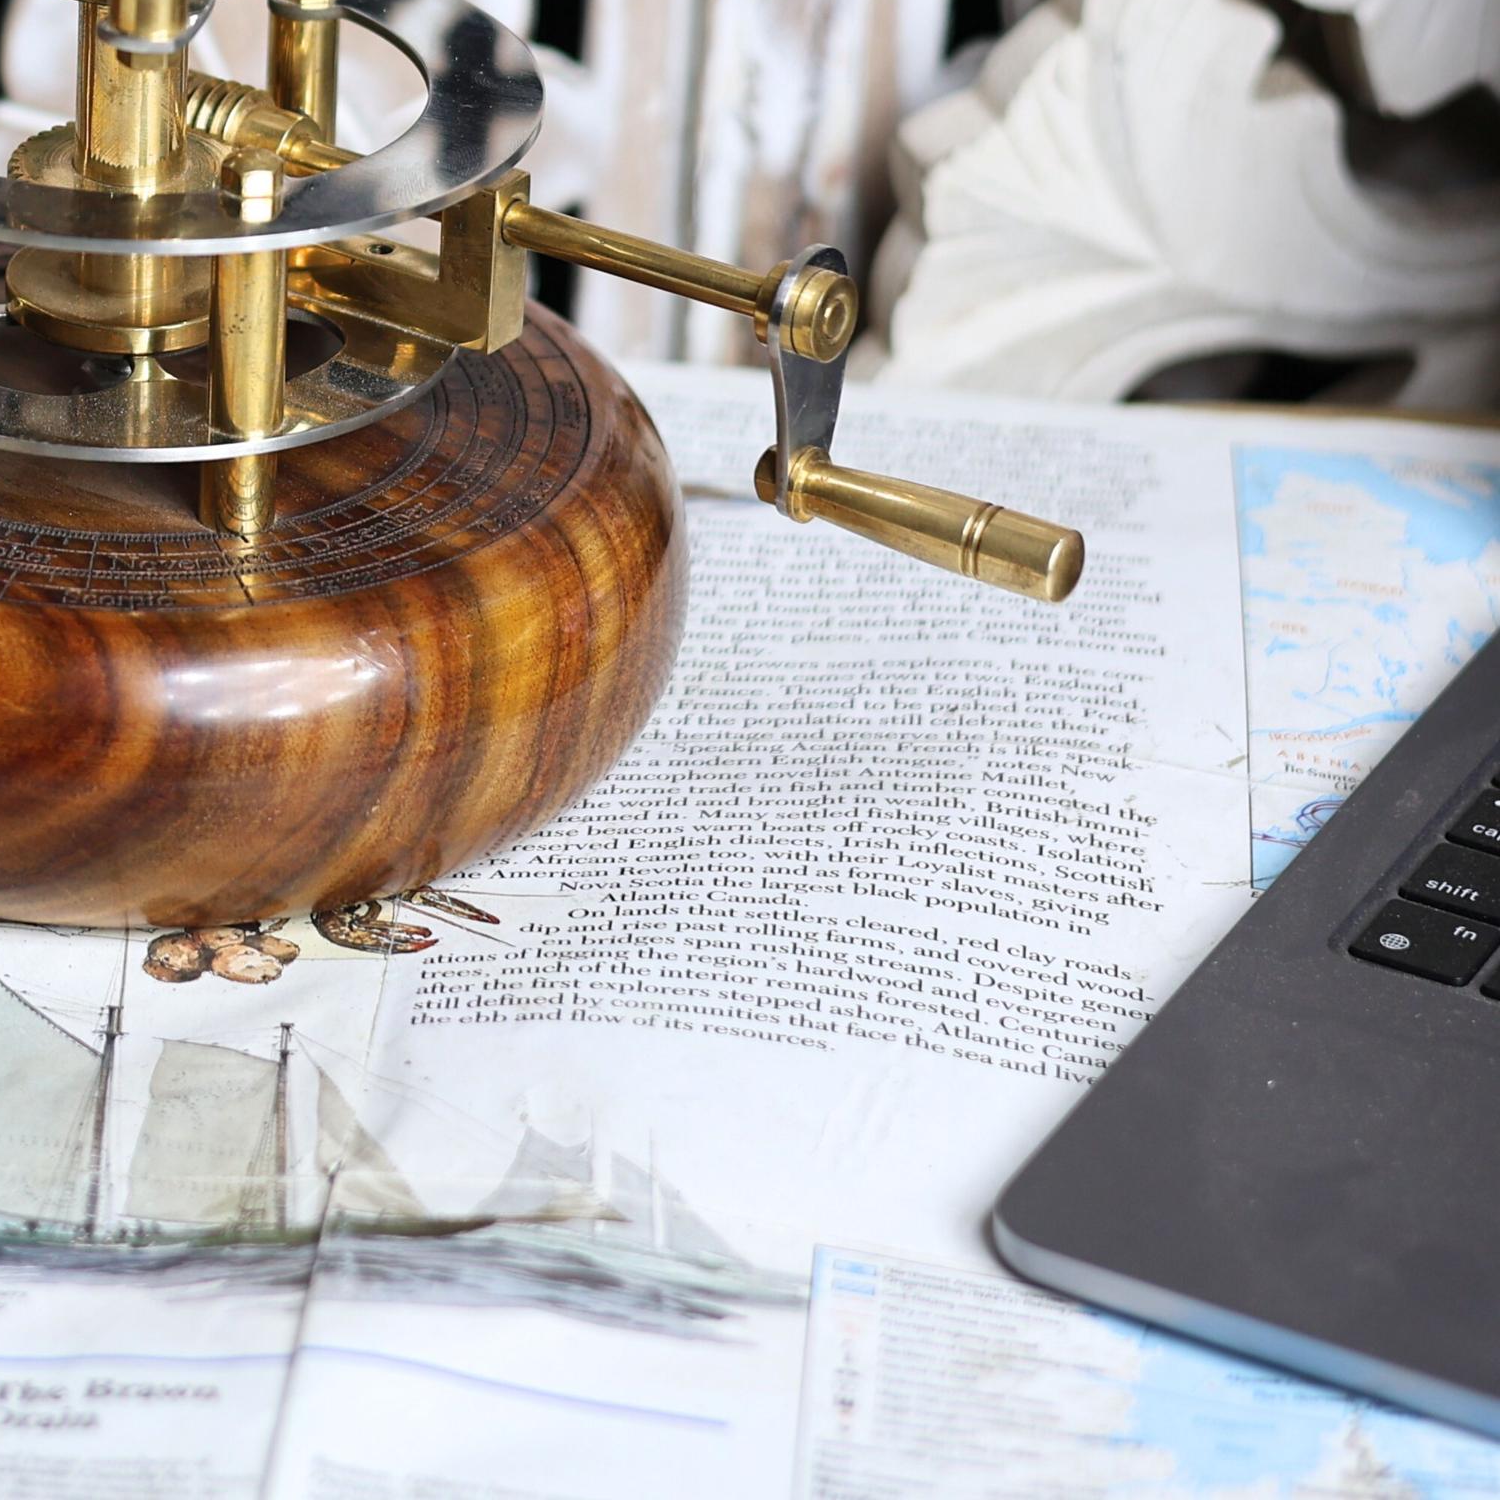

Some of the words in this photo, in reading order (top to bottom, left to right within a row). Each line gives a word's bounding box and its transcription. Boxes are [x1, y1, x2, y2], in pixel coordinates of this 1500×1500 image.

[490, 869, 608, 879] American
[618, 862, 754, 876] Revolution
[762, 864, 808, 876] and
[816, 870, 840, 878] as
[848, 866, 934, 886] former
[941, 878, 1022, 906] slaves,
[1032, 899, 1110, 926] giving
[559, 882, 622, 892] Nova
[629, 876, 704, 888] Scotia
[713, 876, 752, 888] the
[762, 877, 844, 894] largest
[853, 882, 918, 902] black
[926, 896, 1059, 929] population
[1068, 920, 1090, 936] in
[600, 890, 699, 903] Atlantic
[706, 891, 808, 907] Canada.
[1425, 879, 1479, 901] shift
[520, 922, 560, 936] dip
[567, 920, 613, 932] and
[622, 920, 667, 930] rise
[676, 922, 726, 932] past
[735, 923, 818, 943] rolling
[826, 930, 904, 954] farms,
[914, 947, 959, 962] and
[967, 957, 1068, 986] covered
[1076, 980, 1154, 1002] wood-
[568, 908, 605, 919] On
[614, 904, 679, 916] lands
[688, 904, 737, 918] that
[744, 910, 838, 926] settlers
[846, 916, 947, 944] cleared,
[958, 937, 999, 952] red
[1006, 945, 1056, 967] clay
[1064, 959, 1131, 980] roads
[582, 933, 675, 947] bridges
[684, 938, 740, 950] span
[751, 942, 848, 964] rushing
[855, 954, 961, 981] streams.
[974, 972, 1073, 1004] Despite
[1453, 926, 1478, 941] fn
[416, 982, 475, 994] after
[483, 978, 522, 990] the
[532, 977, 580, 988] first
[590, 980, 710, 997] explorers
[718, 990, 821, 1012] stepped
[830, 1004, 922, 1031] ashore,
[934, 1022, 1034, 1053] Atlantic
[421, 969, 490, 980] trees,
[502, 962, 570, 974] much
[578, 961, 606, 973] of
[610, 962, 650, 976] the
[660, 966, 758, 984] interior
[766, 979, 868, 1000] remains
[877, 990, 988, 1024] forested.
[999, 1016, 1123, 1052] Centuries
[422, 953, 496, 964] ations
[504, 948, 532, 960] of
[536, 948, 630, 961] logging
[638, 949, 678, 960] the
[687, 954, 786, 970] region's
[796, 960, 923, 992] hardwood
[932, 986, 977, 1004] and
[986, 998, 1116, 1032] evergreen
[410, 1012, 450, 1026] the
[458, 1010, 507, 1024] ebb
[514, 1008, 562, 1022] and
[571, 1009, 622, 1024] flow
[633, 1014, 660, 1026] of
[665, 1018, 692, 1030] its
[704, 1024, 834, 1050] resources.
[413, 996, 459, 1010] still
[466, 992, 564, 1008] defined
[572, 992, 602, 1008] by
[610, 1000, 780, 1024] communities
[790, 1014, 838, 1032] that
[847, 1022, 896, 1041] face
[905, 1033, 944, 1053] the
[953, 1048, 993, 1064] sea
[1000, 1059, 1046, 1076] and
